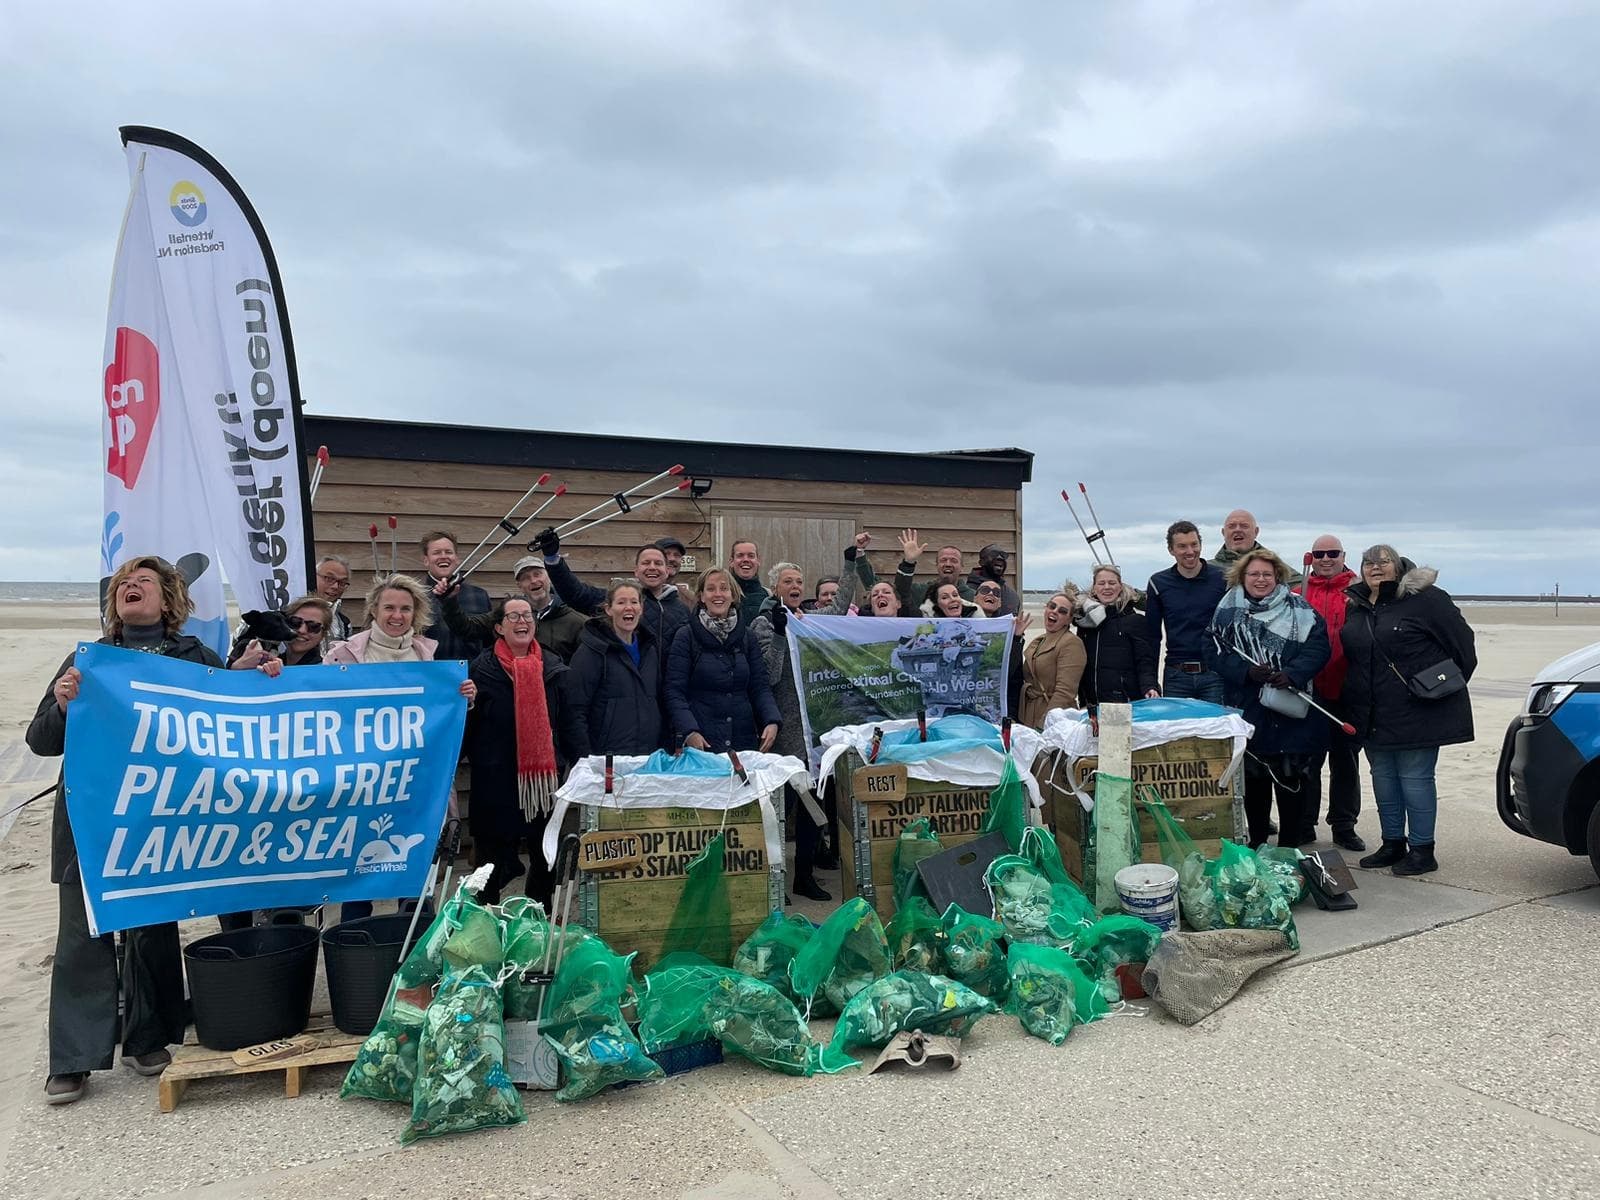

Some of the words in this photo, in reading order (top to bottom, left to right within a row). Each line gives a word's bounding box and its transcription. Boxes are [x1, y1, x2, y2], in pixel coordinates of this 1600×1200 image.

[950, 678, 994, 692] Week
[130, 702, 342, 760] TOGETHER
[355, 706, 424, 753] FOR
[867, 775, 896, 793] REST
[1151, 761, 1212, 782] TALKING.
[113, 764, 319, 816] PLASTIC
[328, 758, 420, 808] FREE
[102, 823, 240, 878] LAND
[239, 821, 274, 865] &
[278, 816, 358, 862] SEA
[585, 837, 637, 863] PLASTIC
[637, 831, 663, 854] OP
[647, 852, 700, 878] STAR
[722, 849, 763, 873] ING!
